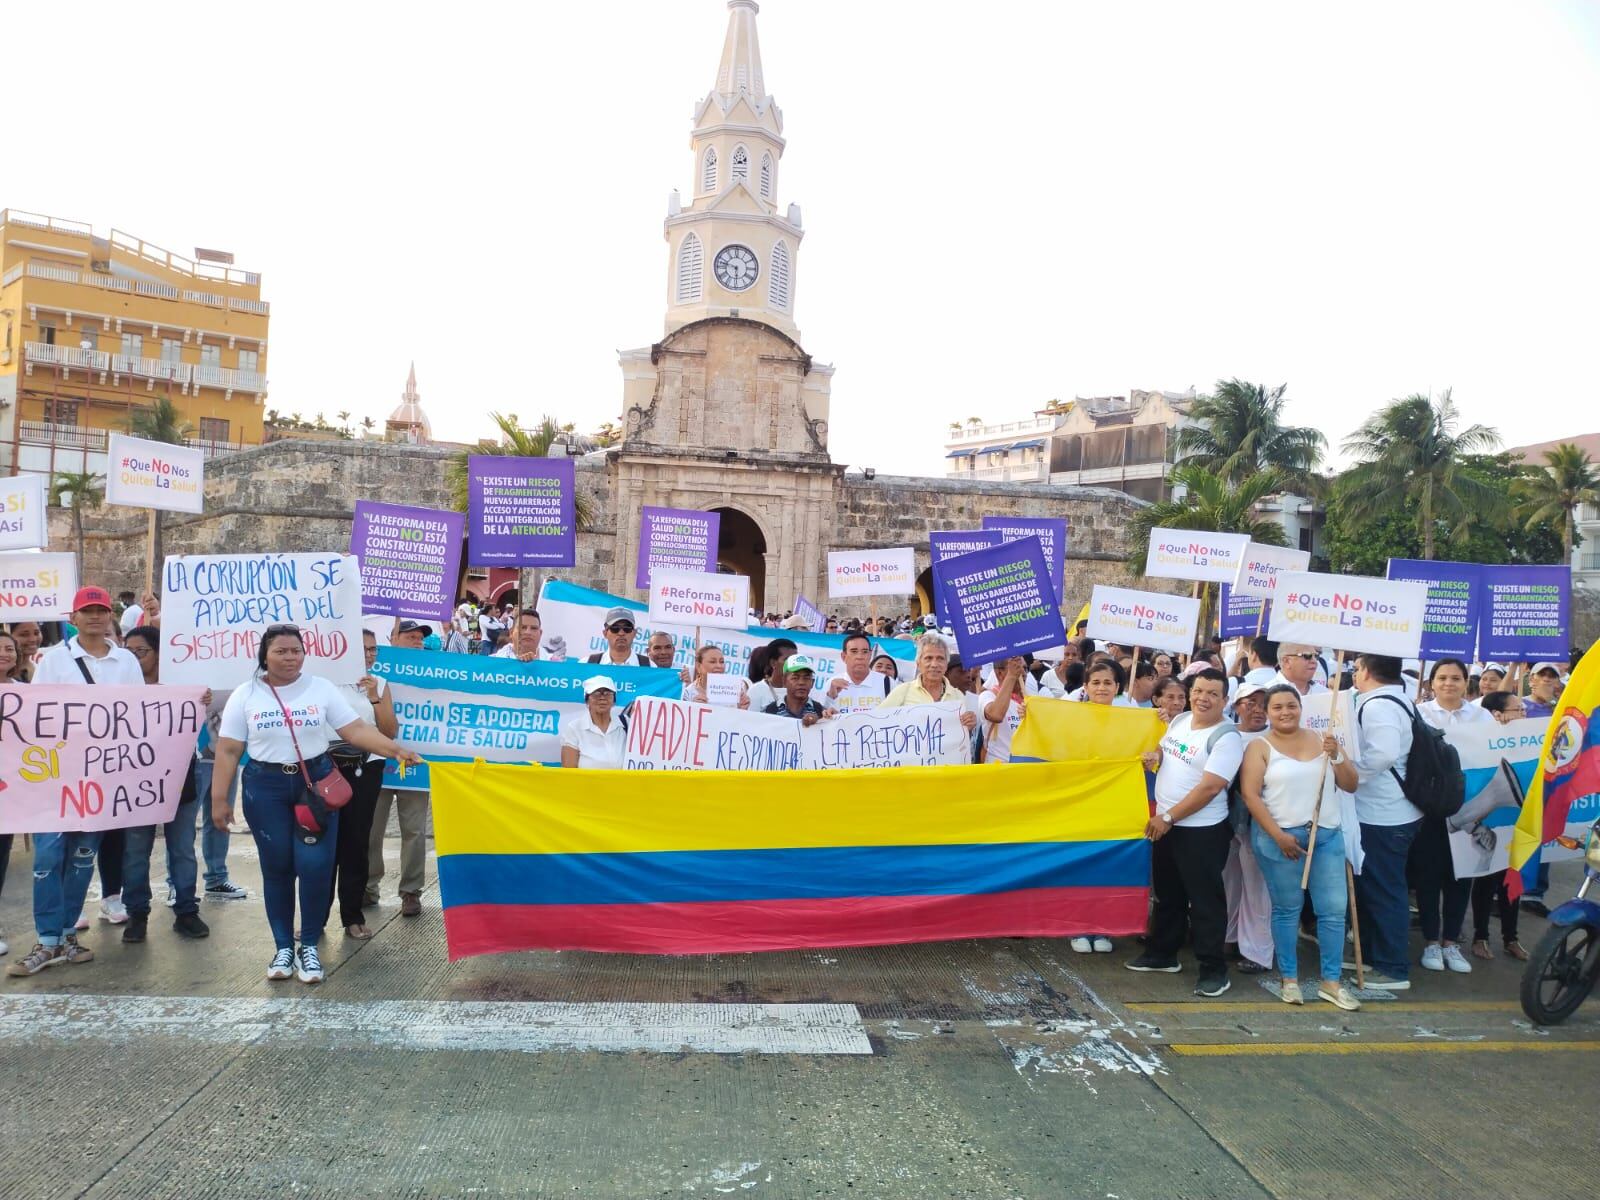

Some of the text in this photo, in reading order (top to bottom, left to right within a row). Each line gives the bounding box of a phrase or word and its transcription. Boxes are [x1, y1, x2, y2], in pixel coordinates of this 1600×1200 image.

[514, 477, 560, 487] UN RIESGO
[484, 497, 512, 505] NUEVAS
[484, 506, 511, 514] ACCESO
[519, 505, 560, 515] AFECTACIÓN
[381, 515, 448, 532] REFORMA DE LA
[484, 515, 493, 523] EN
[506, 516, 561, 524] INTEGRALIDAD
[661, 516, 691, 526] REFORMA
[700, 520, 708, 528] LA
[368, 525, 447, 544] SALUD NO ESTÁ
[484, 525, 510, 535] DE LA
[652, 524, 708, 536] SALUD NO ESTÁ
[366, 537, 445, 555] CONSTRUYENDO
[651, 533, 707, 544] CONSTRUYENDO
[365, 548, 388, 558] SOBRE
[389, 550, 398, 559] LO
[947, 542, 975, 551] REFORMA
[365, 557, 386, 566] TODO
[387, 559, 397, 567] LO
[984, 568, 998, 579] UN
[998, 559, 1032, 574] RIESGO
[167, 554, 344, 596] LA CORRUPCIÓN SE
[362, 567, 442, 584] ESTÁ DESTRUYENDO
[361, 577, 440, 592] EL SISTEMA DE SALUD
[361, 587, 379, 597] QUE
[957, 587, 968, 597] DE
[960, 579, 1037, 605] NUEVAS BARRERAS DE
[1441, 581, 1469, 589] RIESGO
[1532, 585, 1558, 593] RIESGO
[963, 588, 1039, 615] ACCESO Y AFECTACIÓN
[193, 591, 344, 628] APODERA DEL
[965, 597, 1042, 624] EN LA INTEGRALIDAD
[1429, 606, 1467, 615] AFECTACIÓN
[967, 621, 995, 636] DE LA
[1492, 627, 1514, 636] DE LA
[395, 664, 568, 689] USUARIOS MARCHAMOS
[0, 692, 197, 745] REFORMA
[450, 707, 554, 731] SE APODERA
[445, 727, 528, 750] DE SALUD
[629, 699, 713, 766] NADIE
[821, 715, 945, 765] LA REFORMA
[1489, 737, 1516, 750] LOS
[18, 741, 156, 783] SÍ PERO
[60, 768, 171, 818] NO ASÍ
